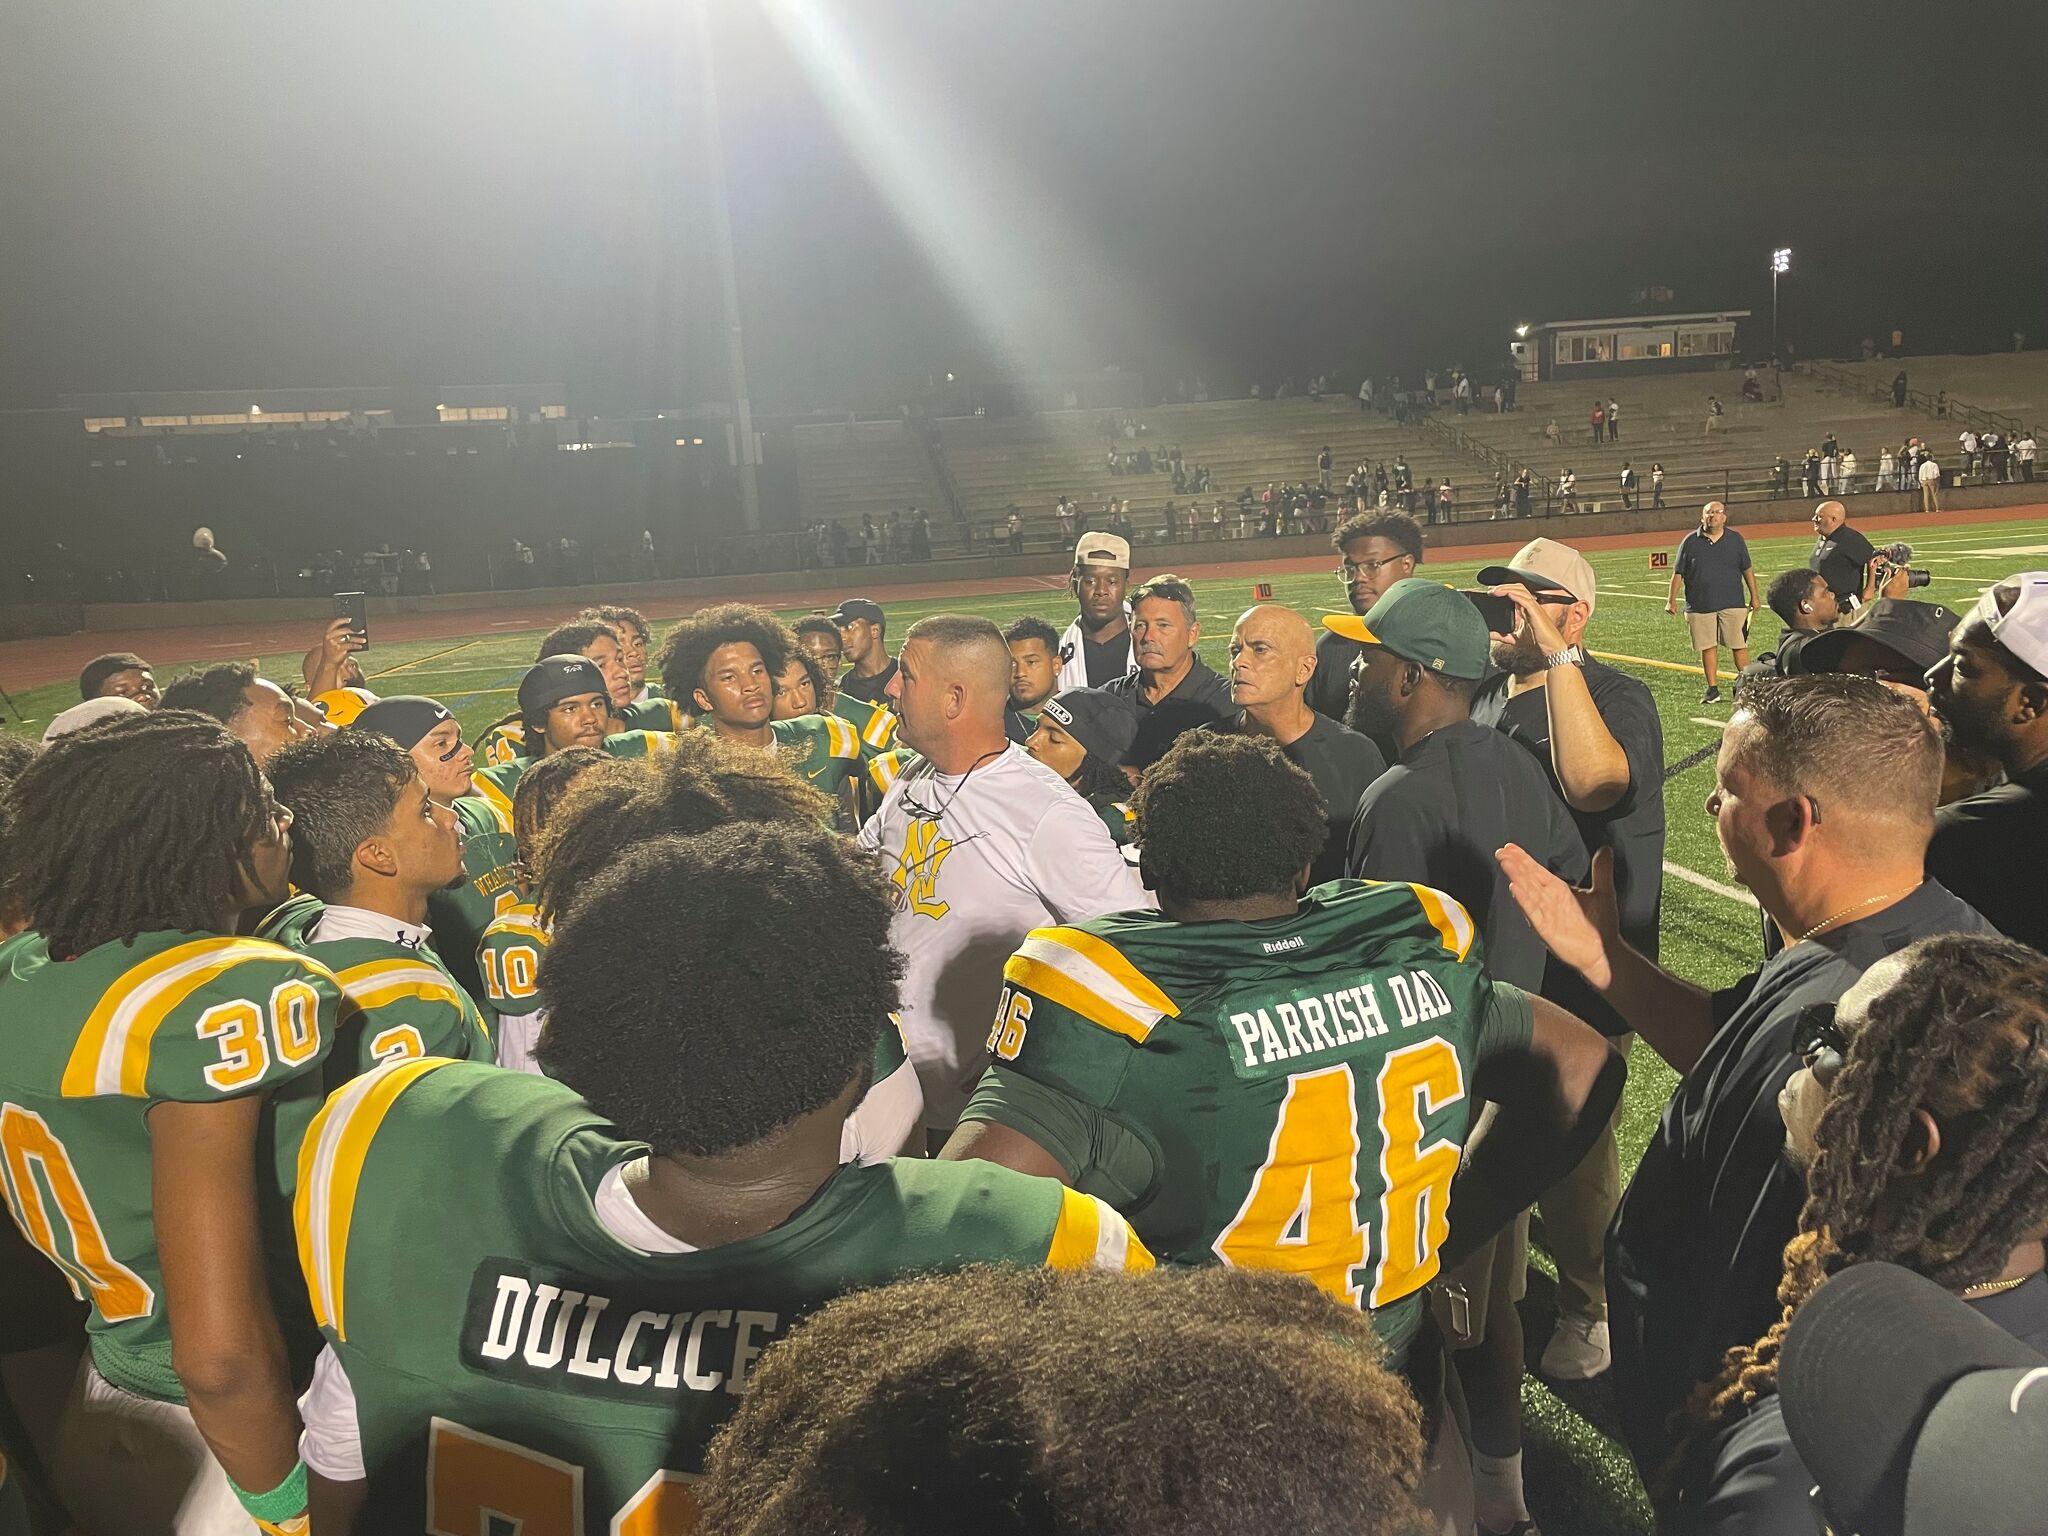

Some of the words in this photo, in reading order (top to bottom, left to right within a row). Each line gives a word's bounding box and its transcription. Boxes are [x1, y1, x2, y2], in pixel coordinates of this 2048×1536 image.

[1258, 583, 1272, 597] 10
[1651, 552, 1668, 567] 20
[482, 945, 540, 999] 10
[1262, 935, 1305, 953] Riddell
[196, 978, 321, 1092] 30
[1229, 983, 1389, 1067] PARRISH
[1387, 969, 1452, 1028] DAD
[1211, 1035, 1465, 1310] 46
[0, 1102, 155, 1323] 0
